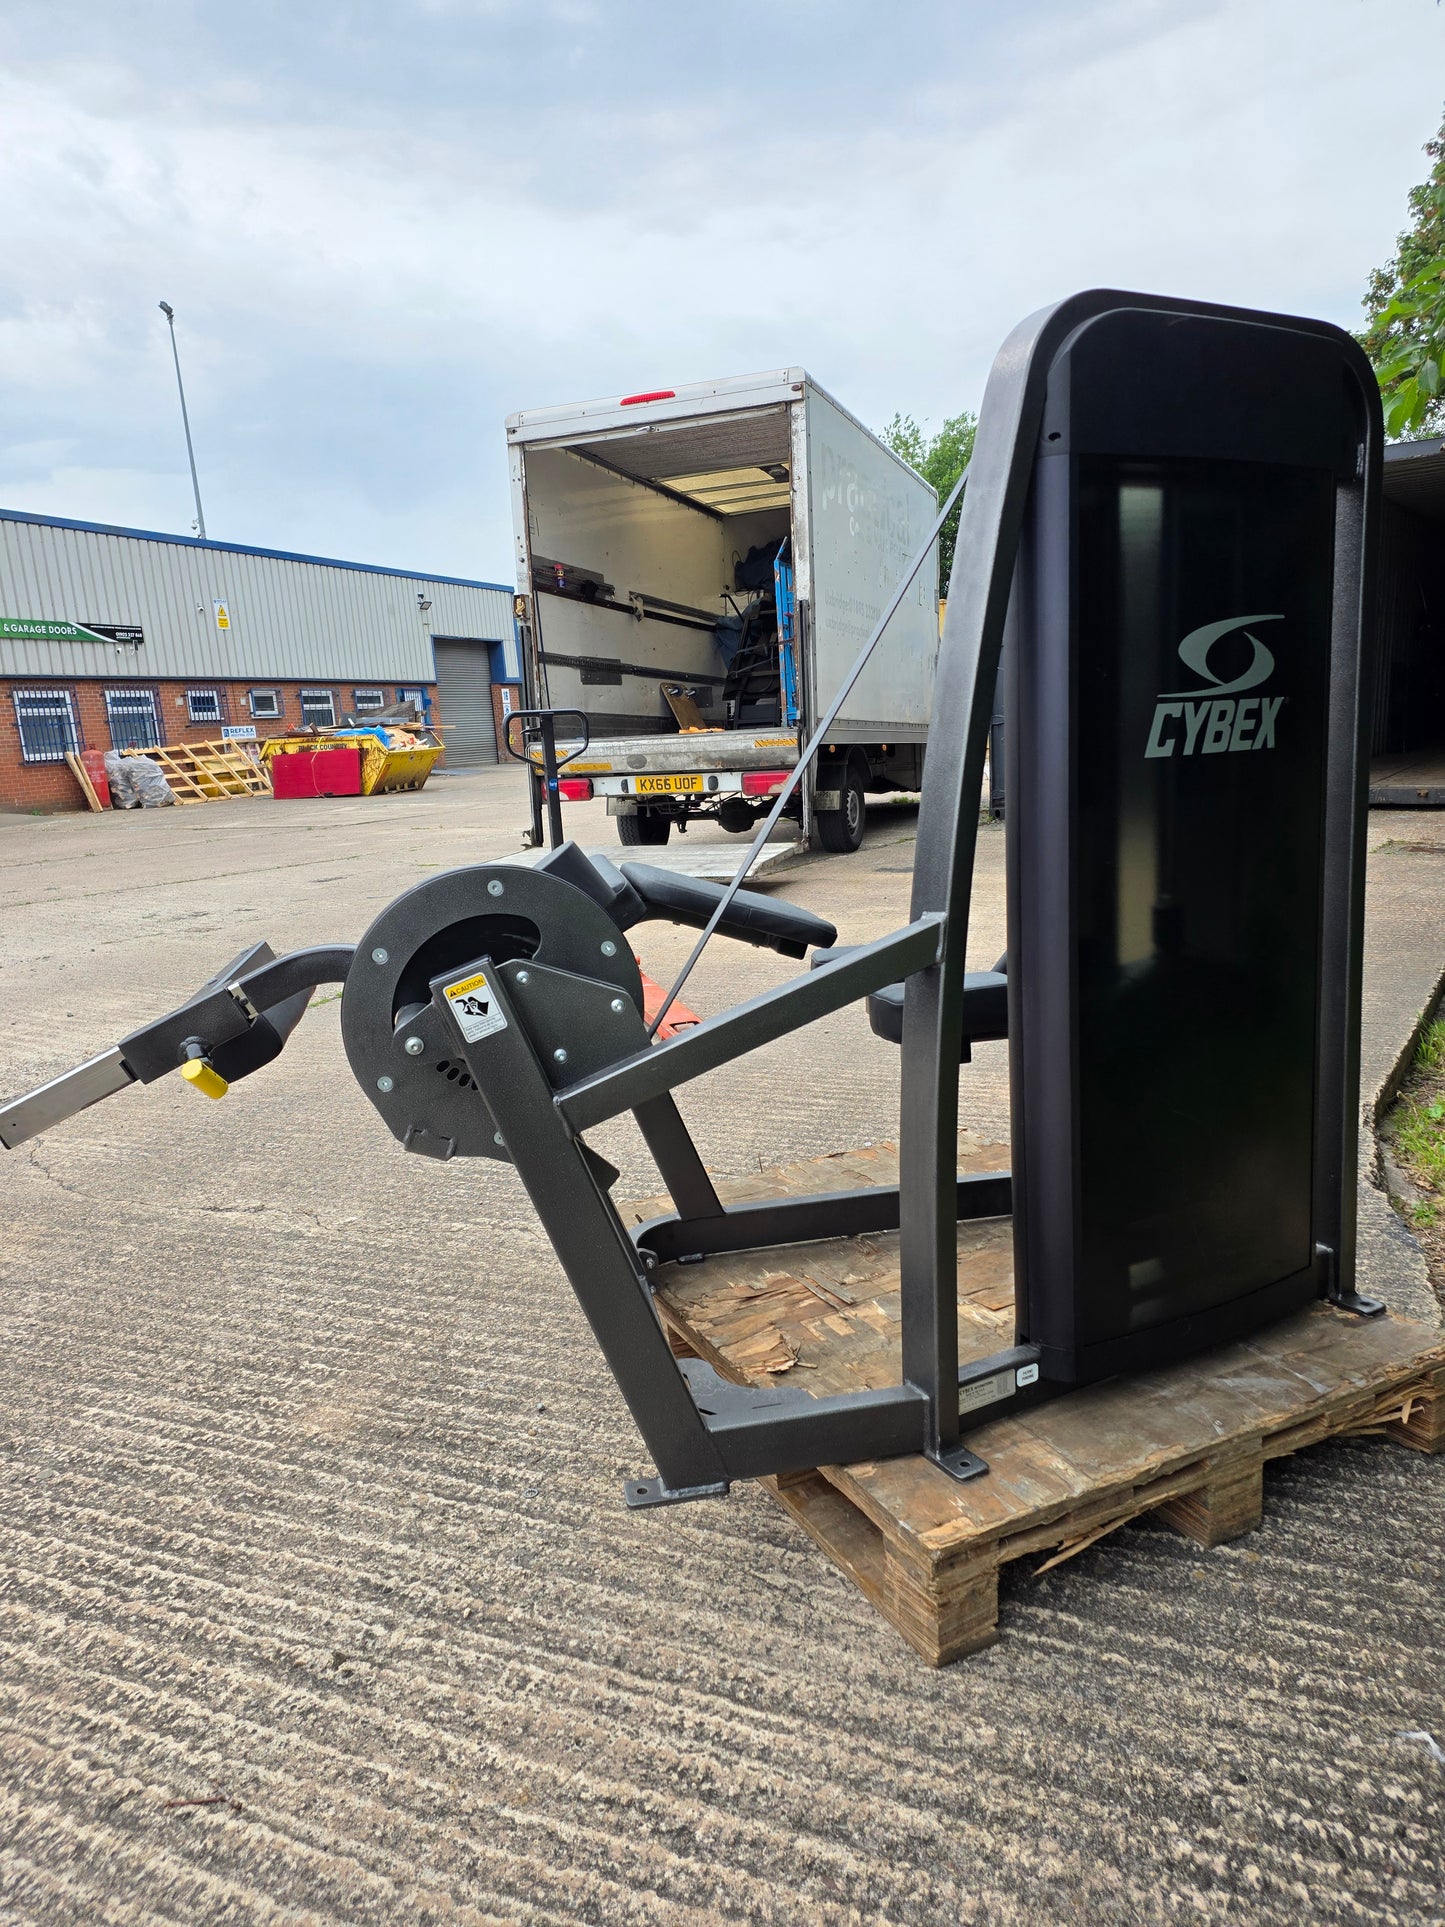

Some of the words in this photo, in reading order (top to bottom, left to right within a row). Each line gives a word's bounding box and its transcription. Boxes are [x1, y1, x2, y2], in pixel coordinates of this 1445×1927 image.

[3, 623, 10, 632] &
[11, 624, 46, 634] GARAGE
[48, 626, 77, 635] DOORS
[1144, 696, 1285, 758] CYBEX
[640, 778, 672, 791] KX66
[675, 777, 698, 790] UOF
[456, 978, 484, 994] CAUTION
